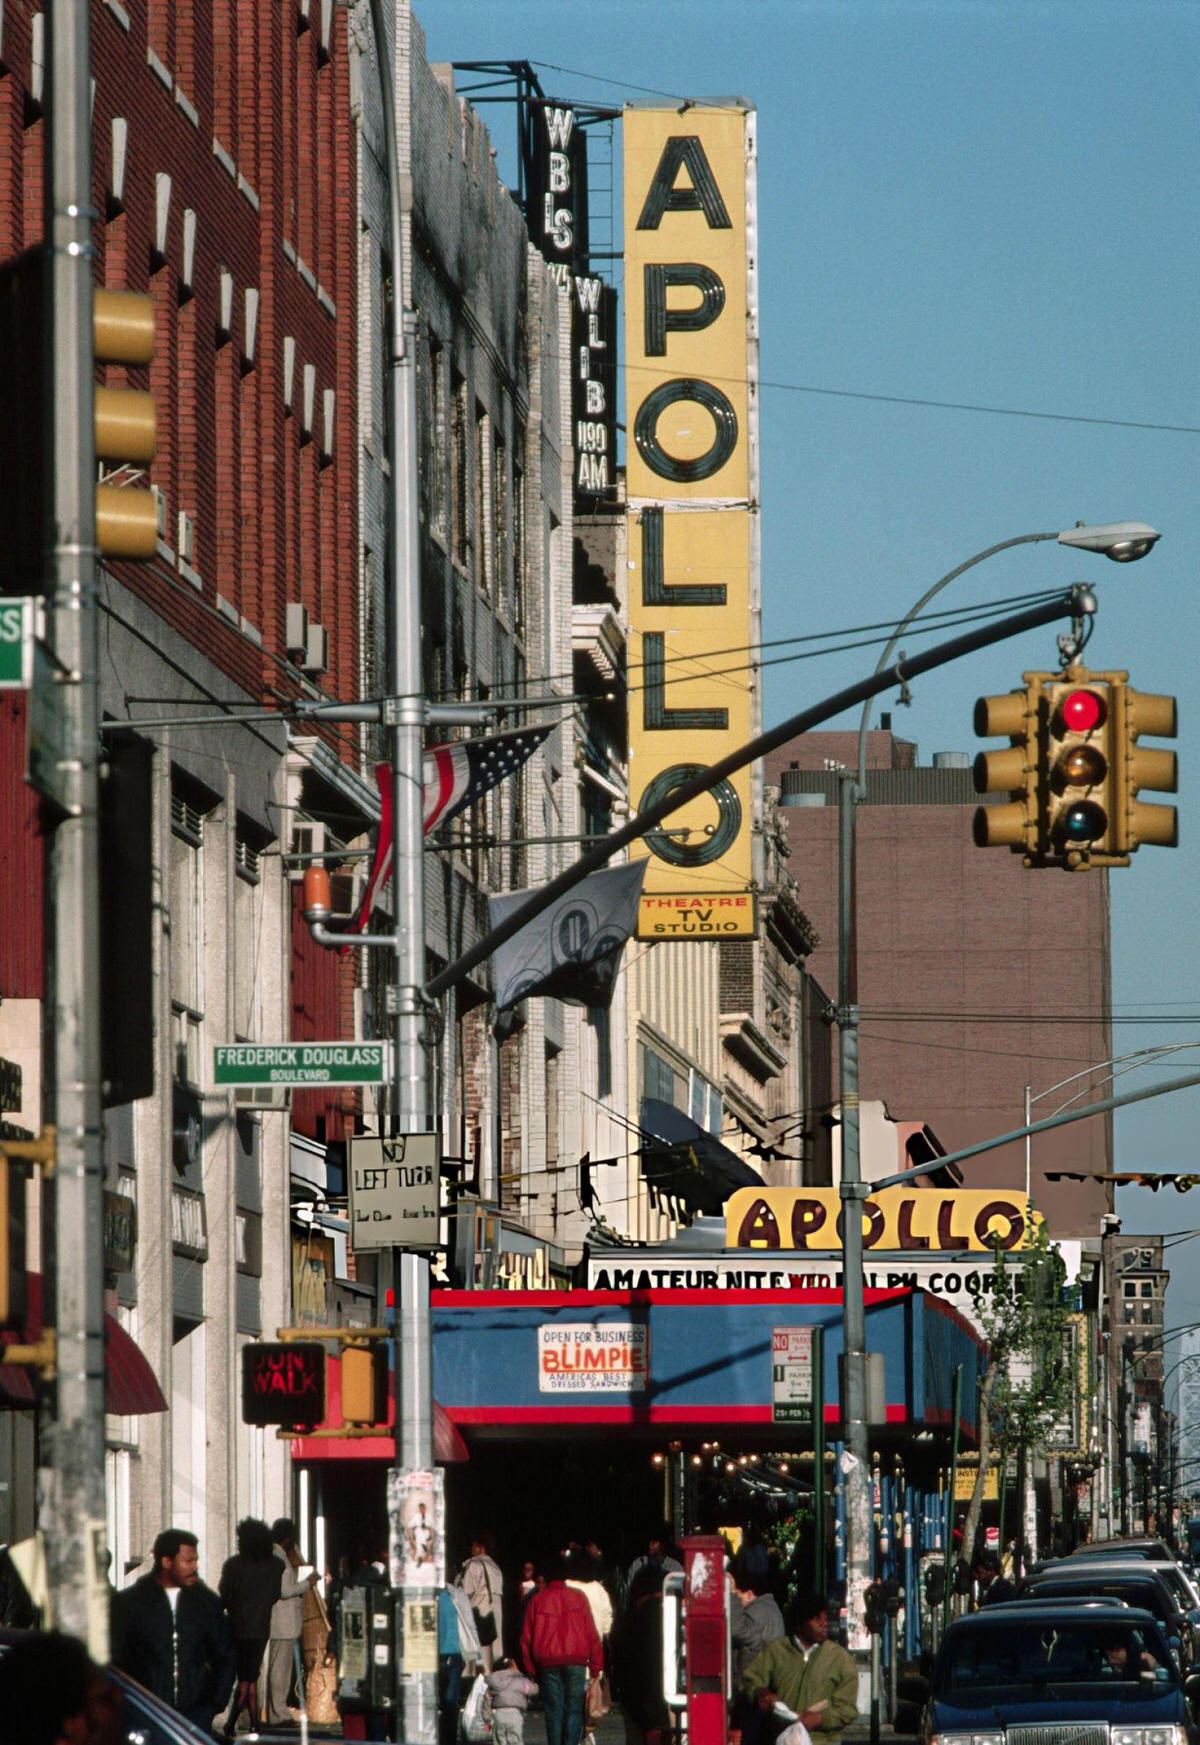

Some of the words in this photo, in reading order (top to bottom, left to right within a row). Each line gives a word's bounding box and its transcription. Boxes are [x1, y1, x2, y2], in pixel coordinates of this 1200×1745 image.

[544, 106, 573, 249] WBLS
[575, 275, 607, 413] WLIB
[577, 420, 607, 453] 1190
[578, 452, 608, 490] AM
[634, 136, 742, 868] APOLLO
[642, 897, 748, 908] THEATRE
[677, 908, 713, 922] TV
[654, 922, 738, 933] STUDIO
[217, 1048, 297, 1066] FREDERICK
[302, 1047, 380, 1065] DOUGLASS
[269, 1068, 330, 1082] BOULEVARD
[355, 1168, 388, 1191] LEFT
[738, 1199, 1025, 1250] APOLLO
[594, 1269, 719, 1290] AMATEUR
[725, 1271, 785, 1289] NITE
[543, 1331, 571, 1343] OPEN
[574, 1331, 592, 1343] FOR
[595, 1330, 645, 1343] BUSINESS
[773, 1334, 788, 1350] NO
[603, 1373, 627, 1381] BEST
